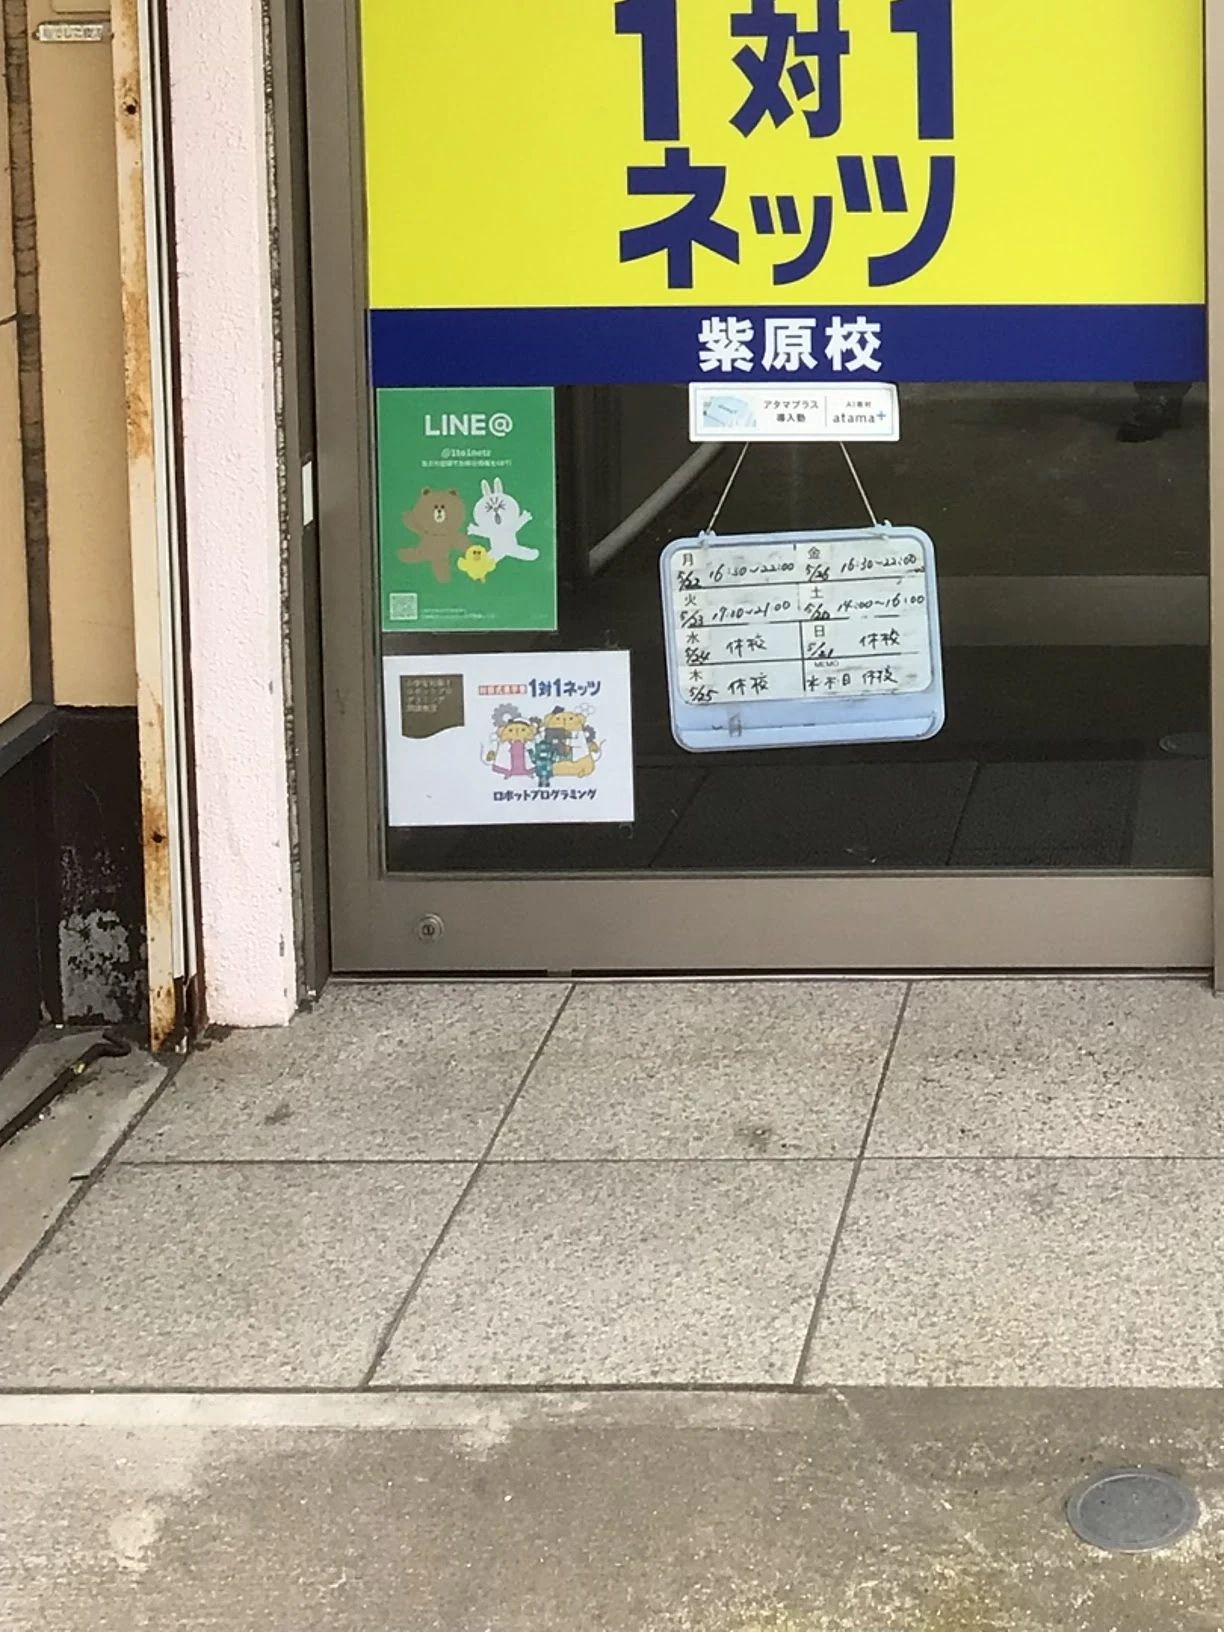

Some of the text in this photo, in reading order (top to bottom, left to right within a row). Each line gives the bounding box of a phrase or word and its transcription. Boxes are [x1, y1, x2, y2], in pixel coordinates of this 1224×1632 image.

[618, 147, 957, 290] ネッツ
[697, 315, 884, 374] 紫原校
[683, 553, 694, 566] 月
[807, 546, 821, 560] 金
[810, 586, 824, 599] 土
[684, 593, 697, 606] 火
[687, 631, 700, 644] 水
[813, 625, 825, 638] 日
[689, 669, 703, 682] 木
